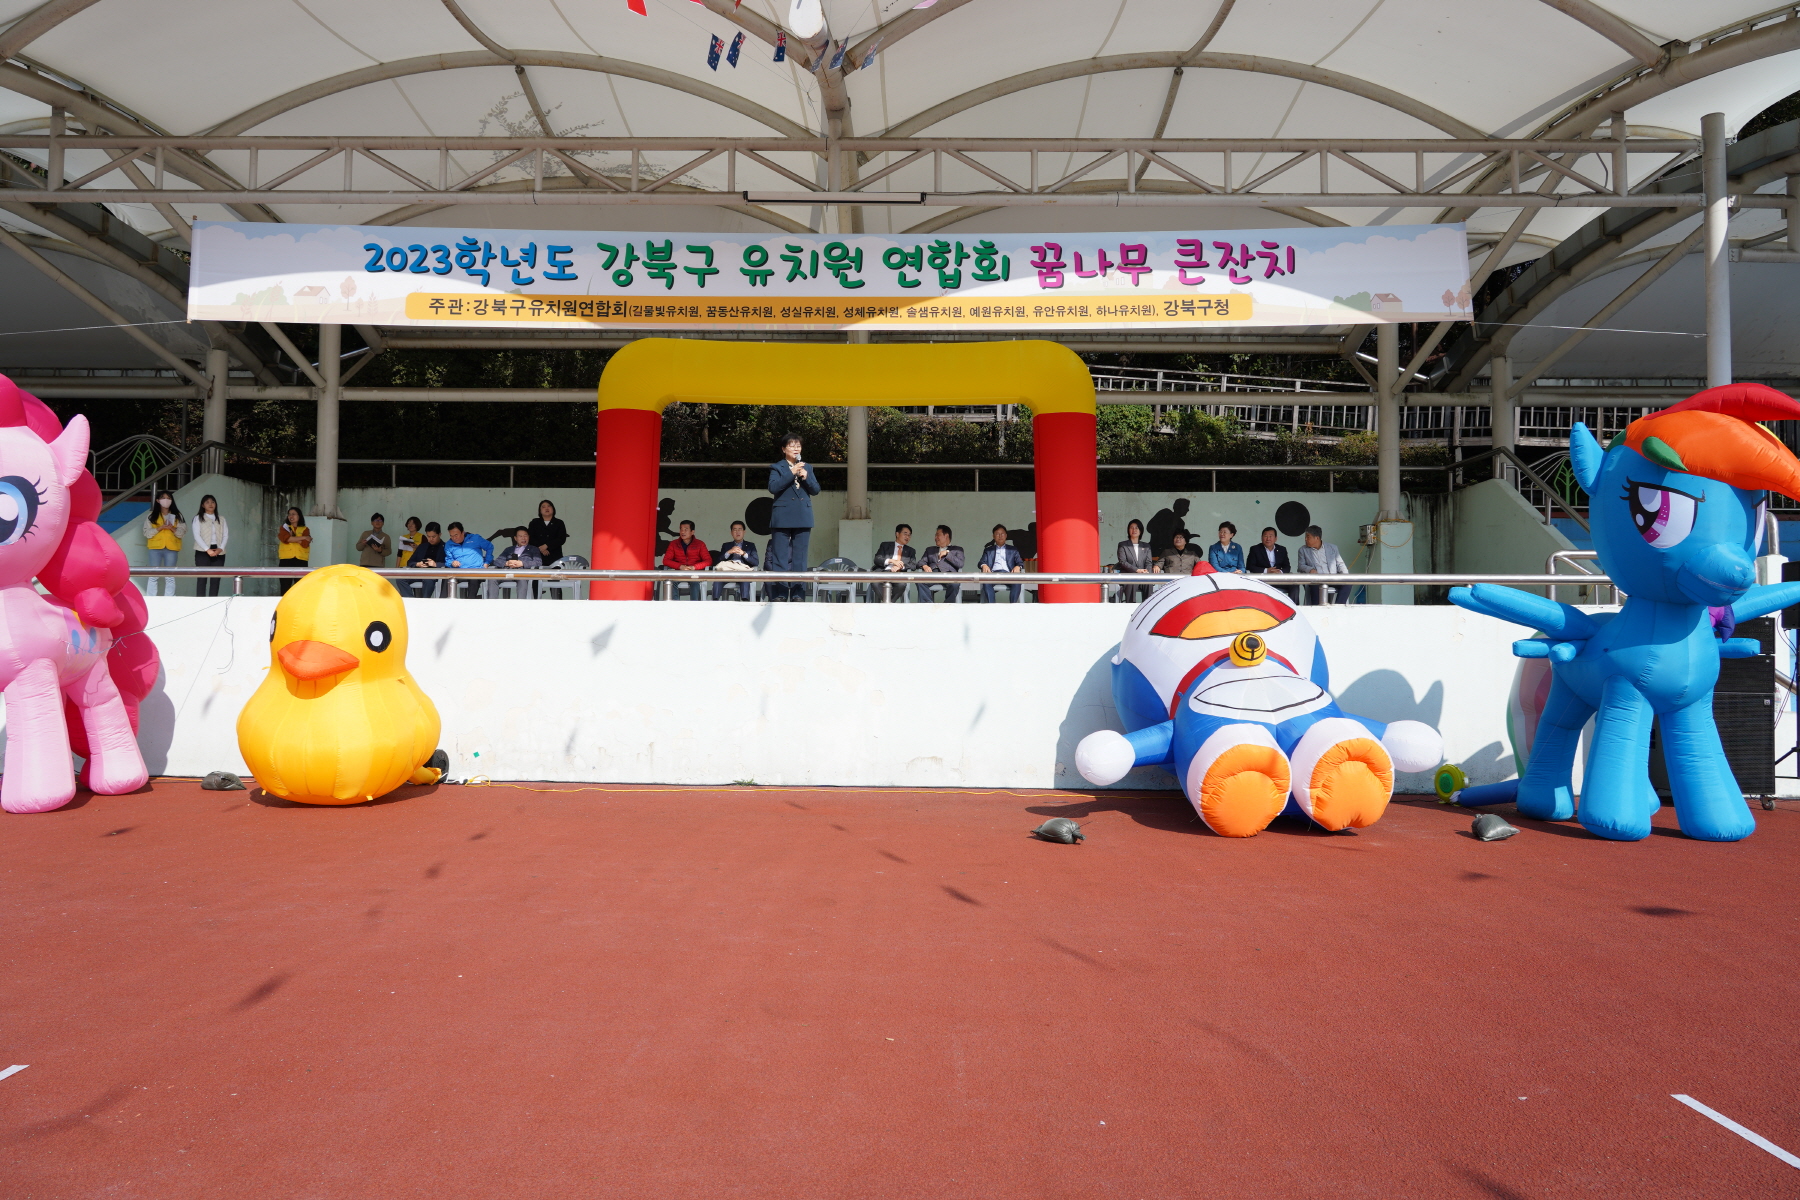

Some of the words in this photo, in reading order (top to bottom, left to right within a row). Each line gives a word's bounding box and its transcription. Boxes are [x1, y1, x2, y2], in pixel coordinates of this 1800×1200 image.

[364, 236, 578, 287] 2023학년도
[597, 239, 719, 289] 강북구
[740, 240, 864, 289] 유치원
[883, 239, 1010, 289] 연합회
[1031, 241, 1152, 289] 꿈나무
[1174, 238, 1295, 284] 큰잔치
[706, 305, 776, 318] 꿈동산유치원,
[780, 305, 839, 318] 성실유치원,
[1163, 298, 1230, 317] 강북구청
